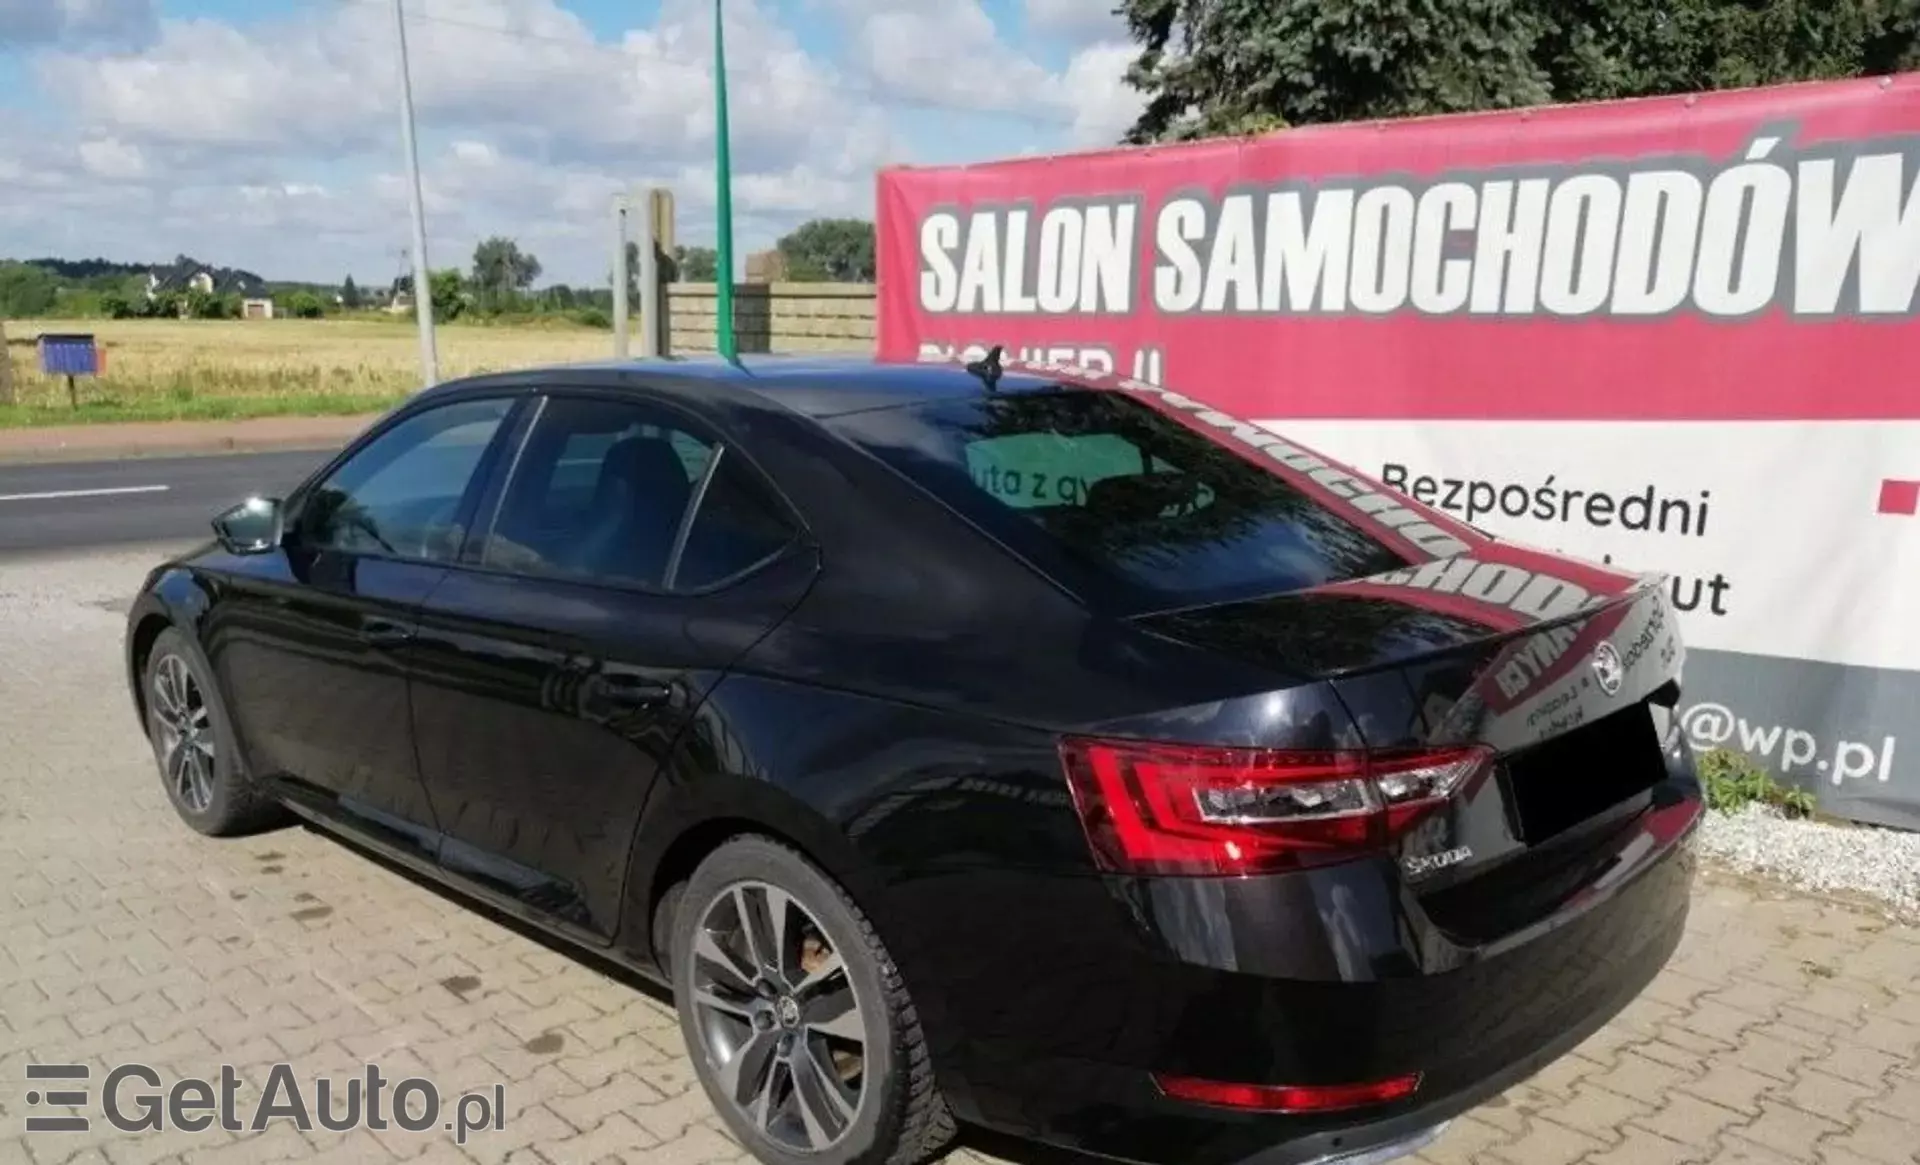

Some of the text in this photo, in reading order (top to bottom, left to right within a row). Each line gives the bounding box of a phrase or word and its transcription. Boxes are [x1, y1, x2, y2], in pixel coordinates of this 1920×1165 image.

[920, 137, 1920, 313] SALON SAMOCHODÓW
[1380, 462, 1711, 537] Bezpośredni
[1670, 573, 1731, 616] ut
[1680, 702, 1897, 786] @wp.pl
